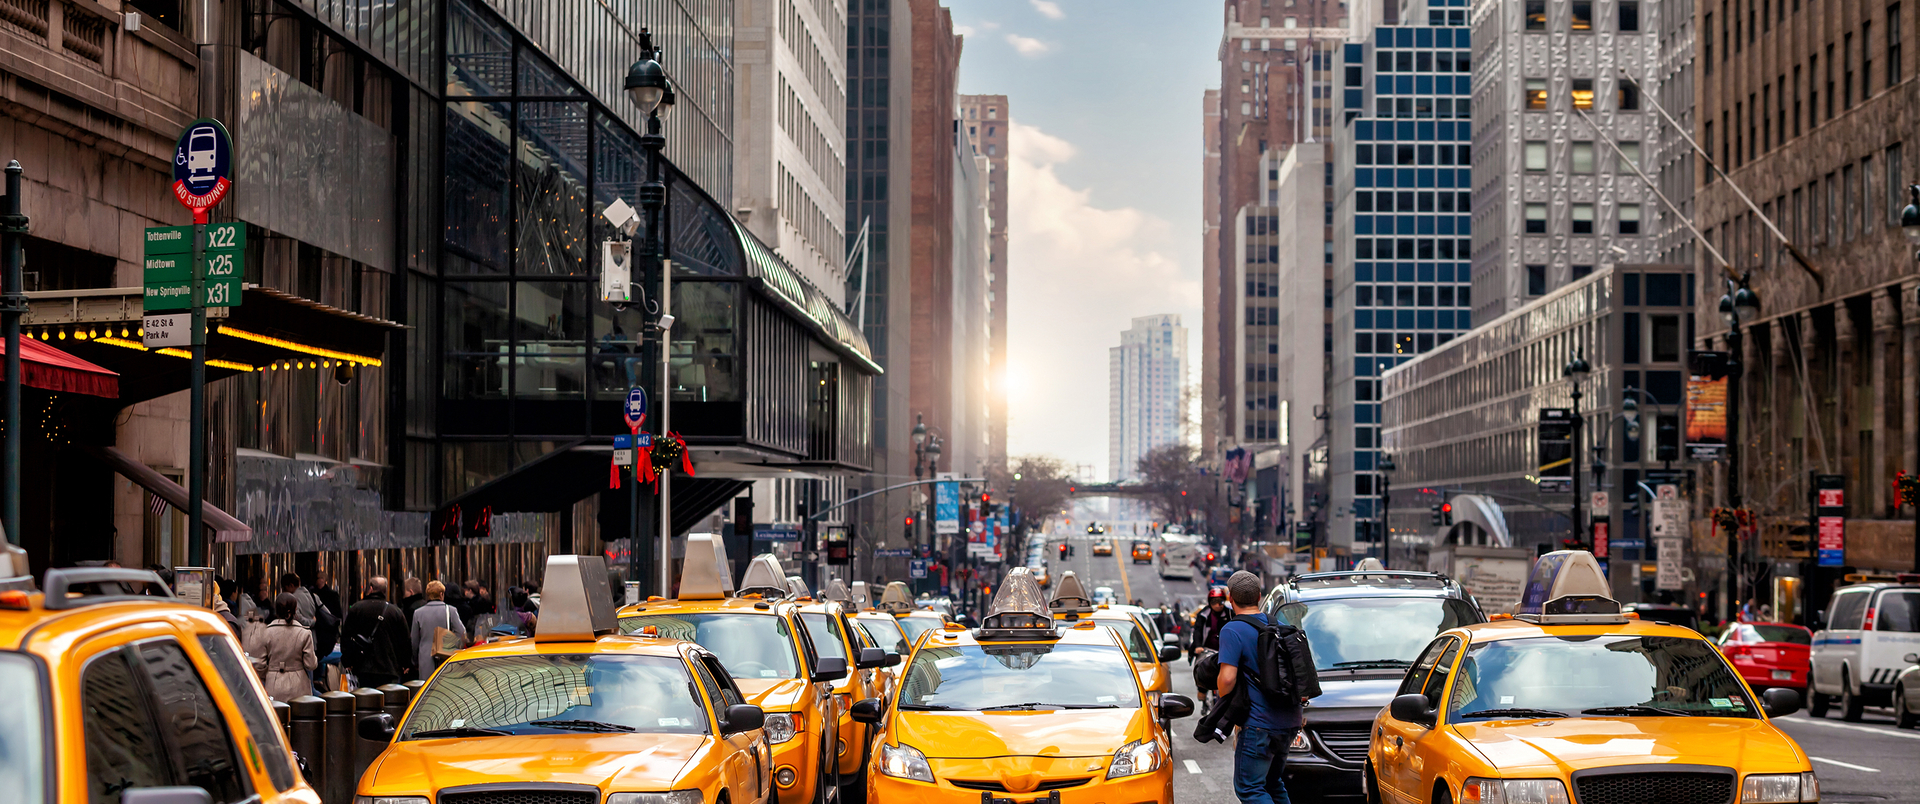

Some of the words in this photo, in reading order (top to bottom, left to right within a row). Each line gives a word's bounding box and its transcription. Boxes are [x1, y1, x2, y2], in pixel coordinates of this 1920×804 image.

[176, 183, 187, 199] NO
[186, 182, 225, 208] STANDING
[146, 230, 182, 242] Tottenville
[208, 226, 236, 248] x22
[146, 259, 176, 270] Midtown
[208, 254, 234, 276] x25
[146, 287, 159, 297] New
[160, 285, 191, 298] Springville
[207, 282, 230, 304] x31
[146, 320, 150, 328] E
[151, 319, 160, 328] 42
[161, 319, 168, 327] St
[169, 318, 174, 327] &
[146, 331, 159, 340] Park
[160, 330, 169, 339] Av
[638, 435, 650, 446] M42
[755, 531, 785, 540] Lexington
[786, 531, 797, 539] Ave
